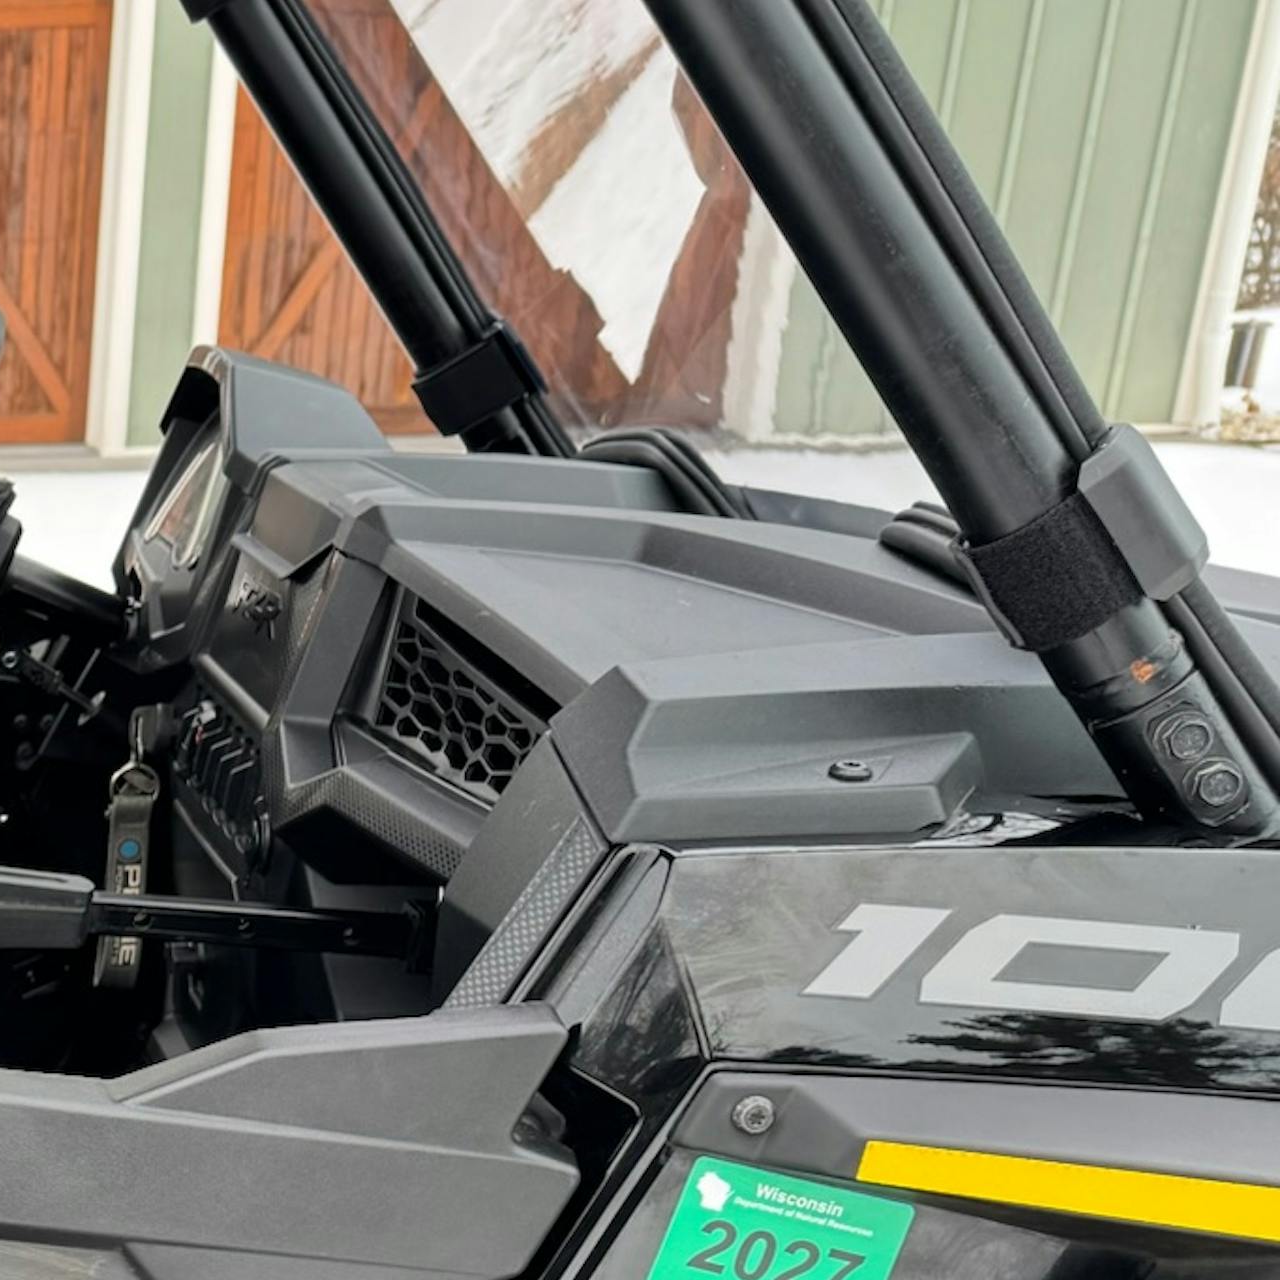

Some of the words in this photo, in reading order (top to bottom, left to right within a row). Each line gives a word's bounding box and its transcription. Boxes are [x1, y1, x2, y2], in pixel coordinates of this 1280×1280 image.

[800, 902, 1280, 1032] 10
[754, 1183, 844, 1217] Wisconsin
[794, 1210, 826, 1226] Natural
